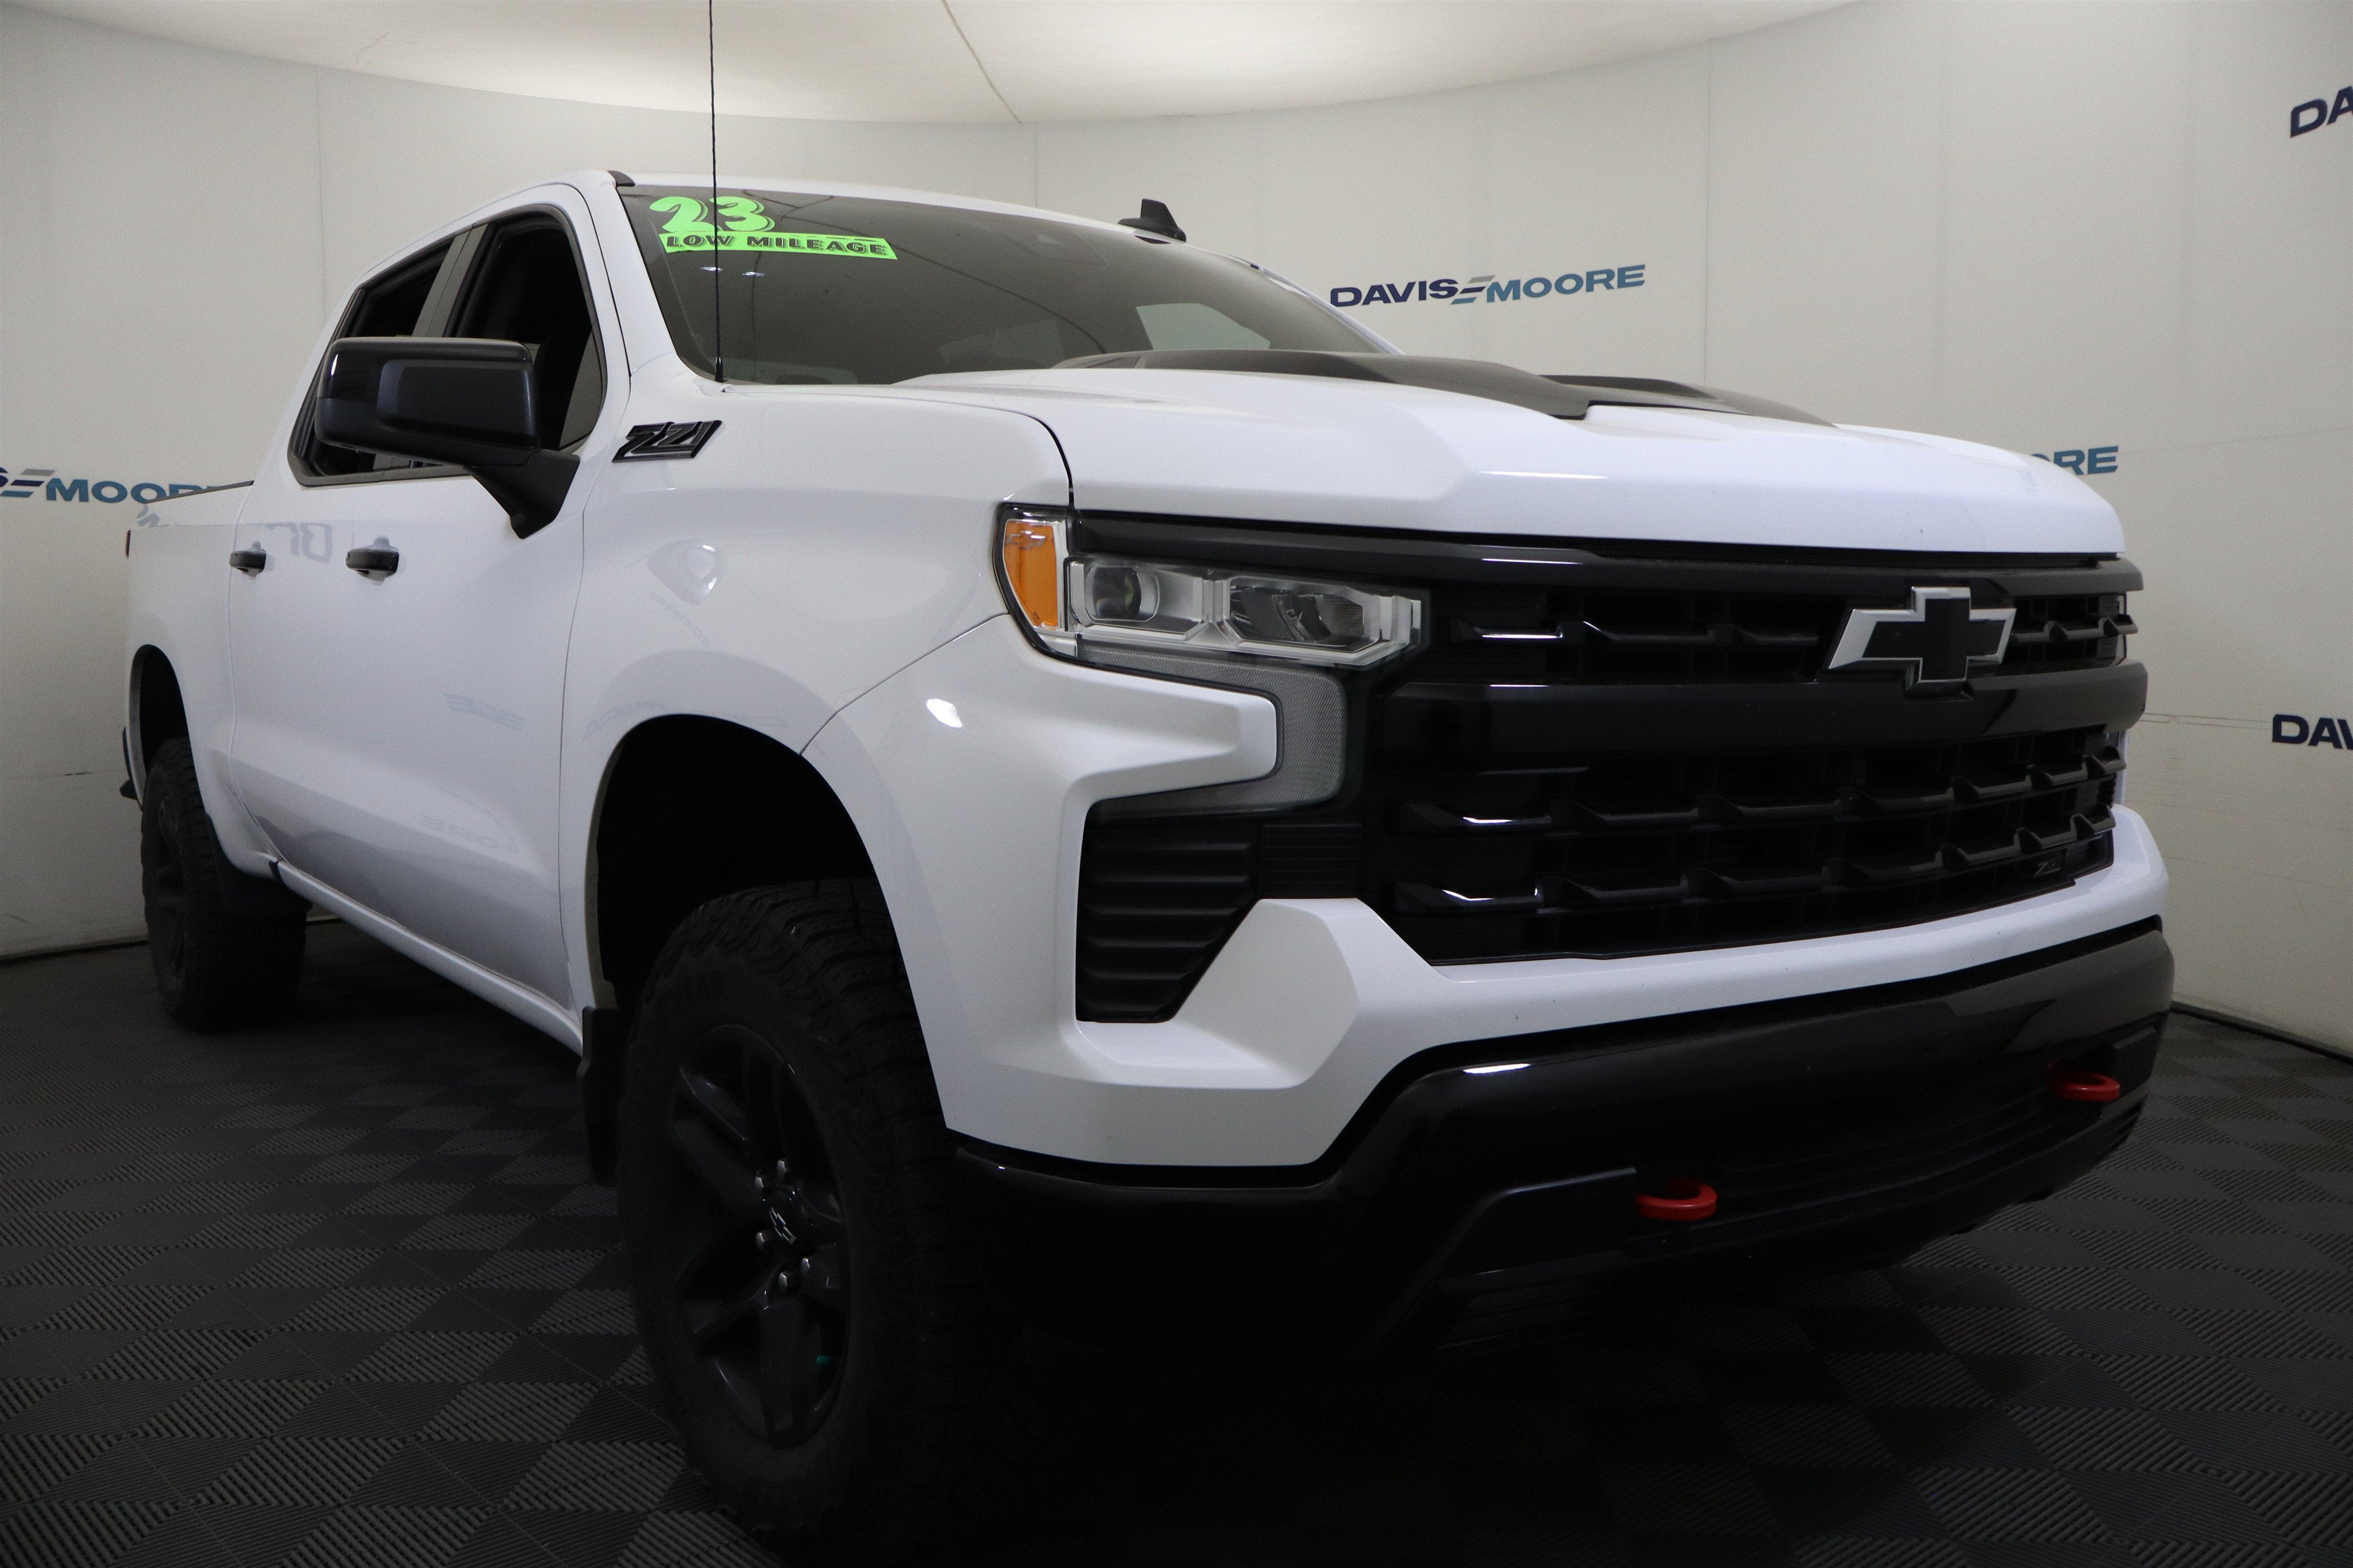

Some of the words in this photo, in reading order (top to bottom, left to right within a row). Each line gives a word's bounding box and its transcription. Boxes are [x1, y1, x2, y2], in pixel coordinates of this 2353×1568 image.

[649, 196, 775, 233] 23
[666, 234, 734, 247] LOW
[747, 235, 885, 255] MILEAGE
[1330, 279, 1459, 308] DAVIS
[1486, 264, 1646, 303] MOORE
[2031, 446, 2119, 476] RE
